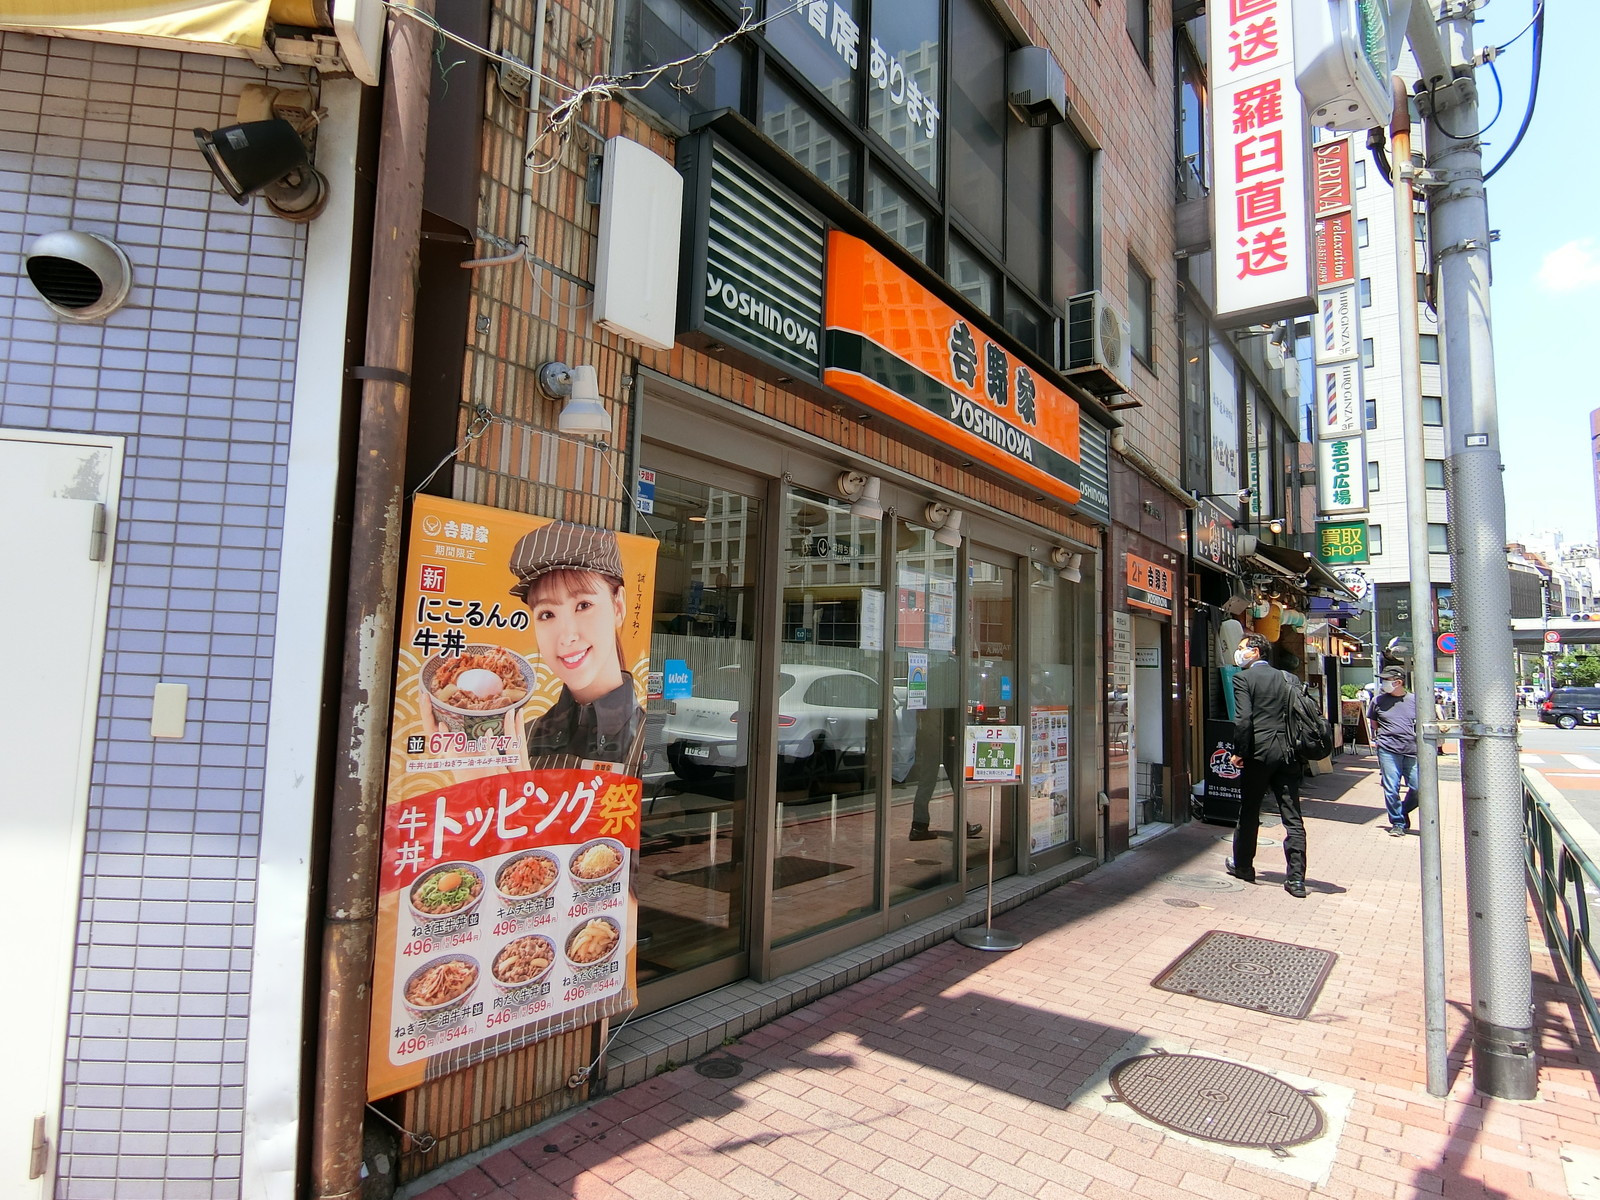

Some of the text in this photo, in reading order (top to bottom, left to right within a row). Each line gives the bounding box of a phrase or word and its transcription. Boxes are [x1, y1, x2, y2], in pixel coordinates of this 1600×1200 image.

[1232, 78, 1289, 280] 羅臼直送
[1317, 145, 1342, 211] SARINA
[1333, 219, 1347, 278] relaxation
[706, 272, 818, 355] YOSHINOYA
[1339, 348, 1351, 356] 3F
[948, 319, 1038, 427] 吉野家
[949, 393, 1033, 462] YOSHINOYA
[1342, 422, 1354, 431] 3F
[1331, 441, 1351, 505] 宝石広場
[443, 520, 490, 543] 吉野家
[1321, 528, 1362, 546] 買取
[435, 544, 476, 560] 期間限定
[1322, 545, 1363, 556] SHOP
[422, 568, 443, 589] 新
[417, 596, 530, 631] にこるんの
[412, 628, 467, 657] 牛丼
[668, 673, 689, 684] Wolt
[408, 736, 425, 754] 並
[986, 729, 1003, 739] 2F
[394, 776, 639, 876] 牛丼 トッピング祭
